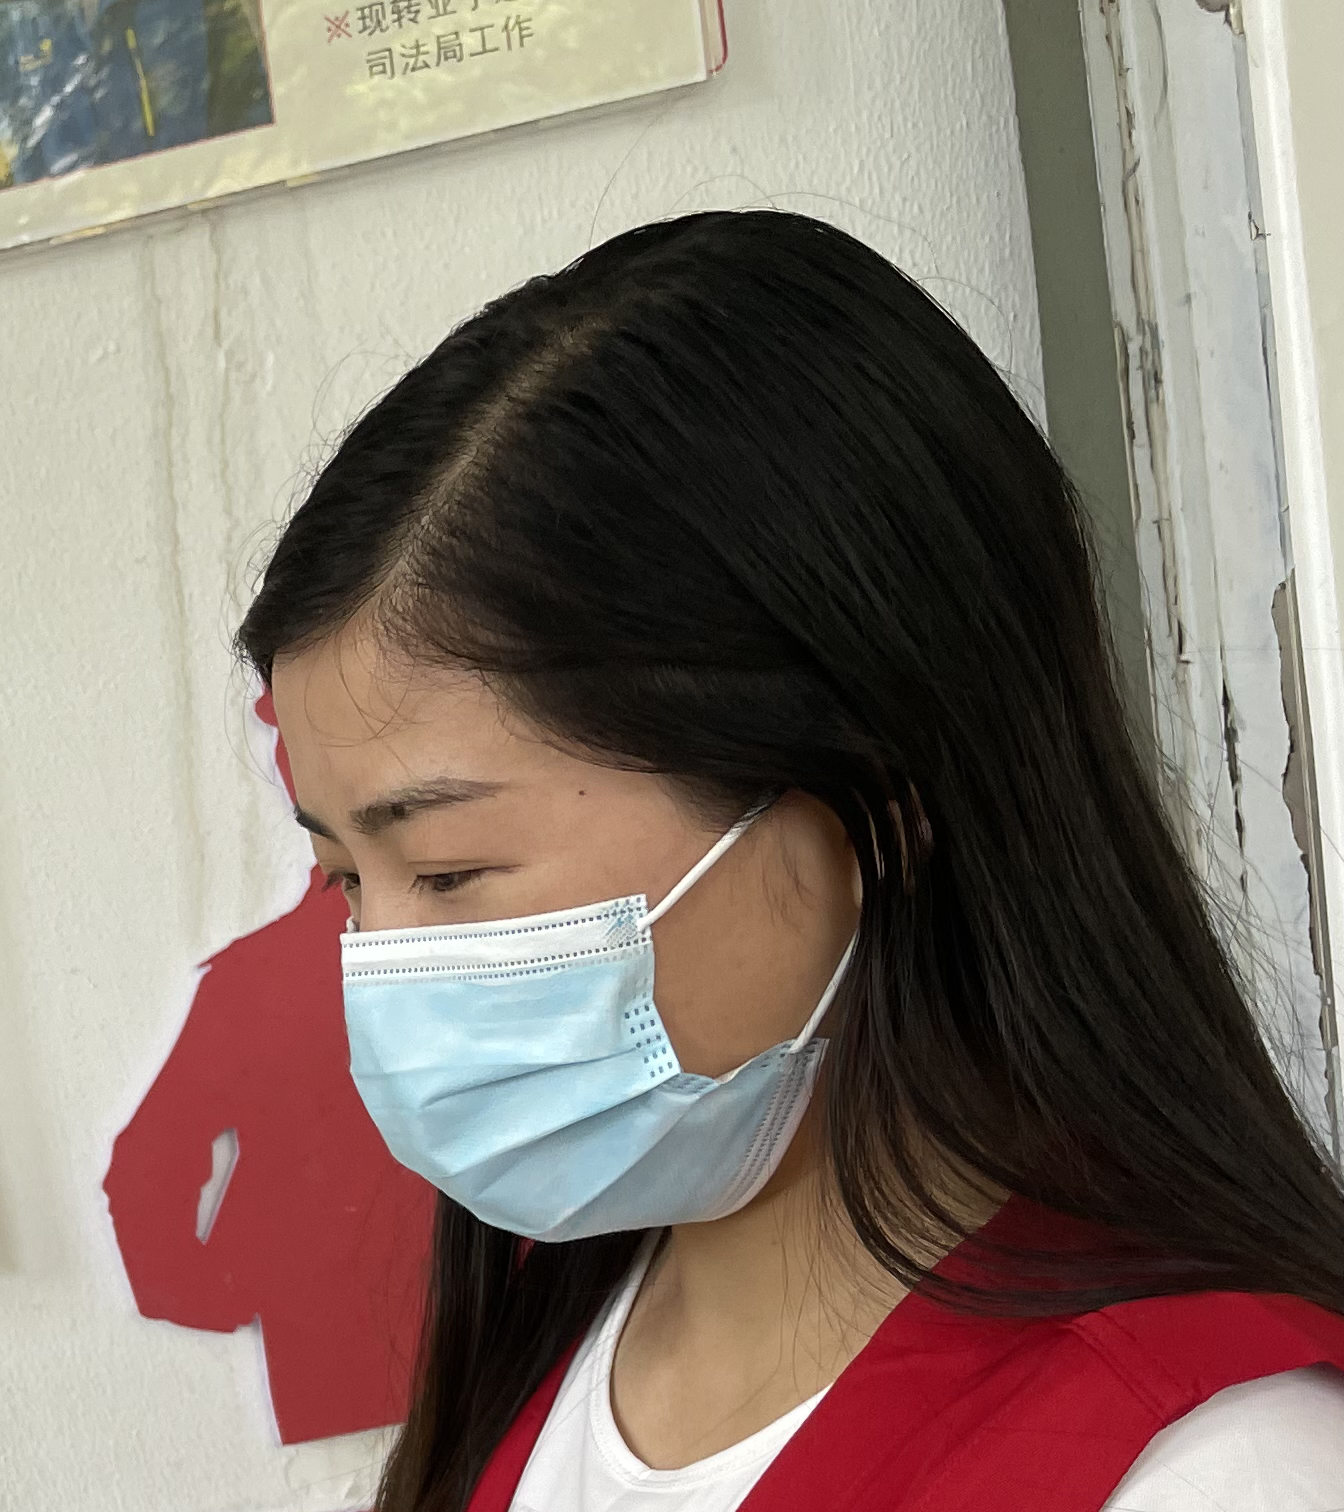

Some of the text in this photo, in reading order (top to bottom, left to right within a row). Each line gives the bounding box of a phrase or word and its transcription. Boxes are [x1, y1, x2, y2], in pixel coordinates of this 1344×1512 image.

[366, 14, 535, 80] 司法局工作
